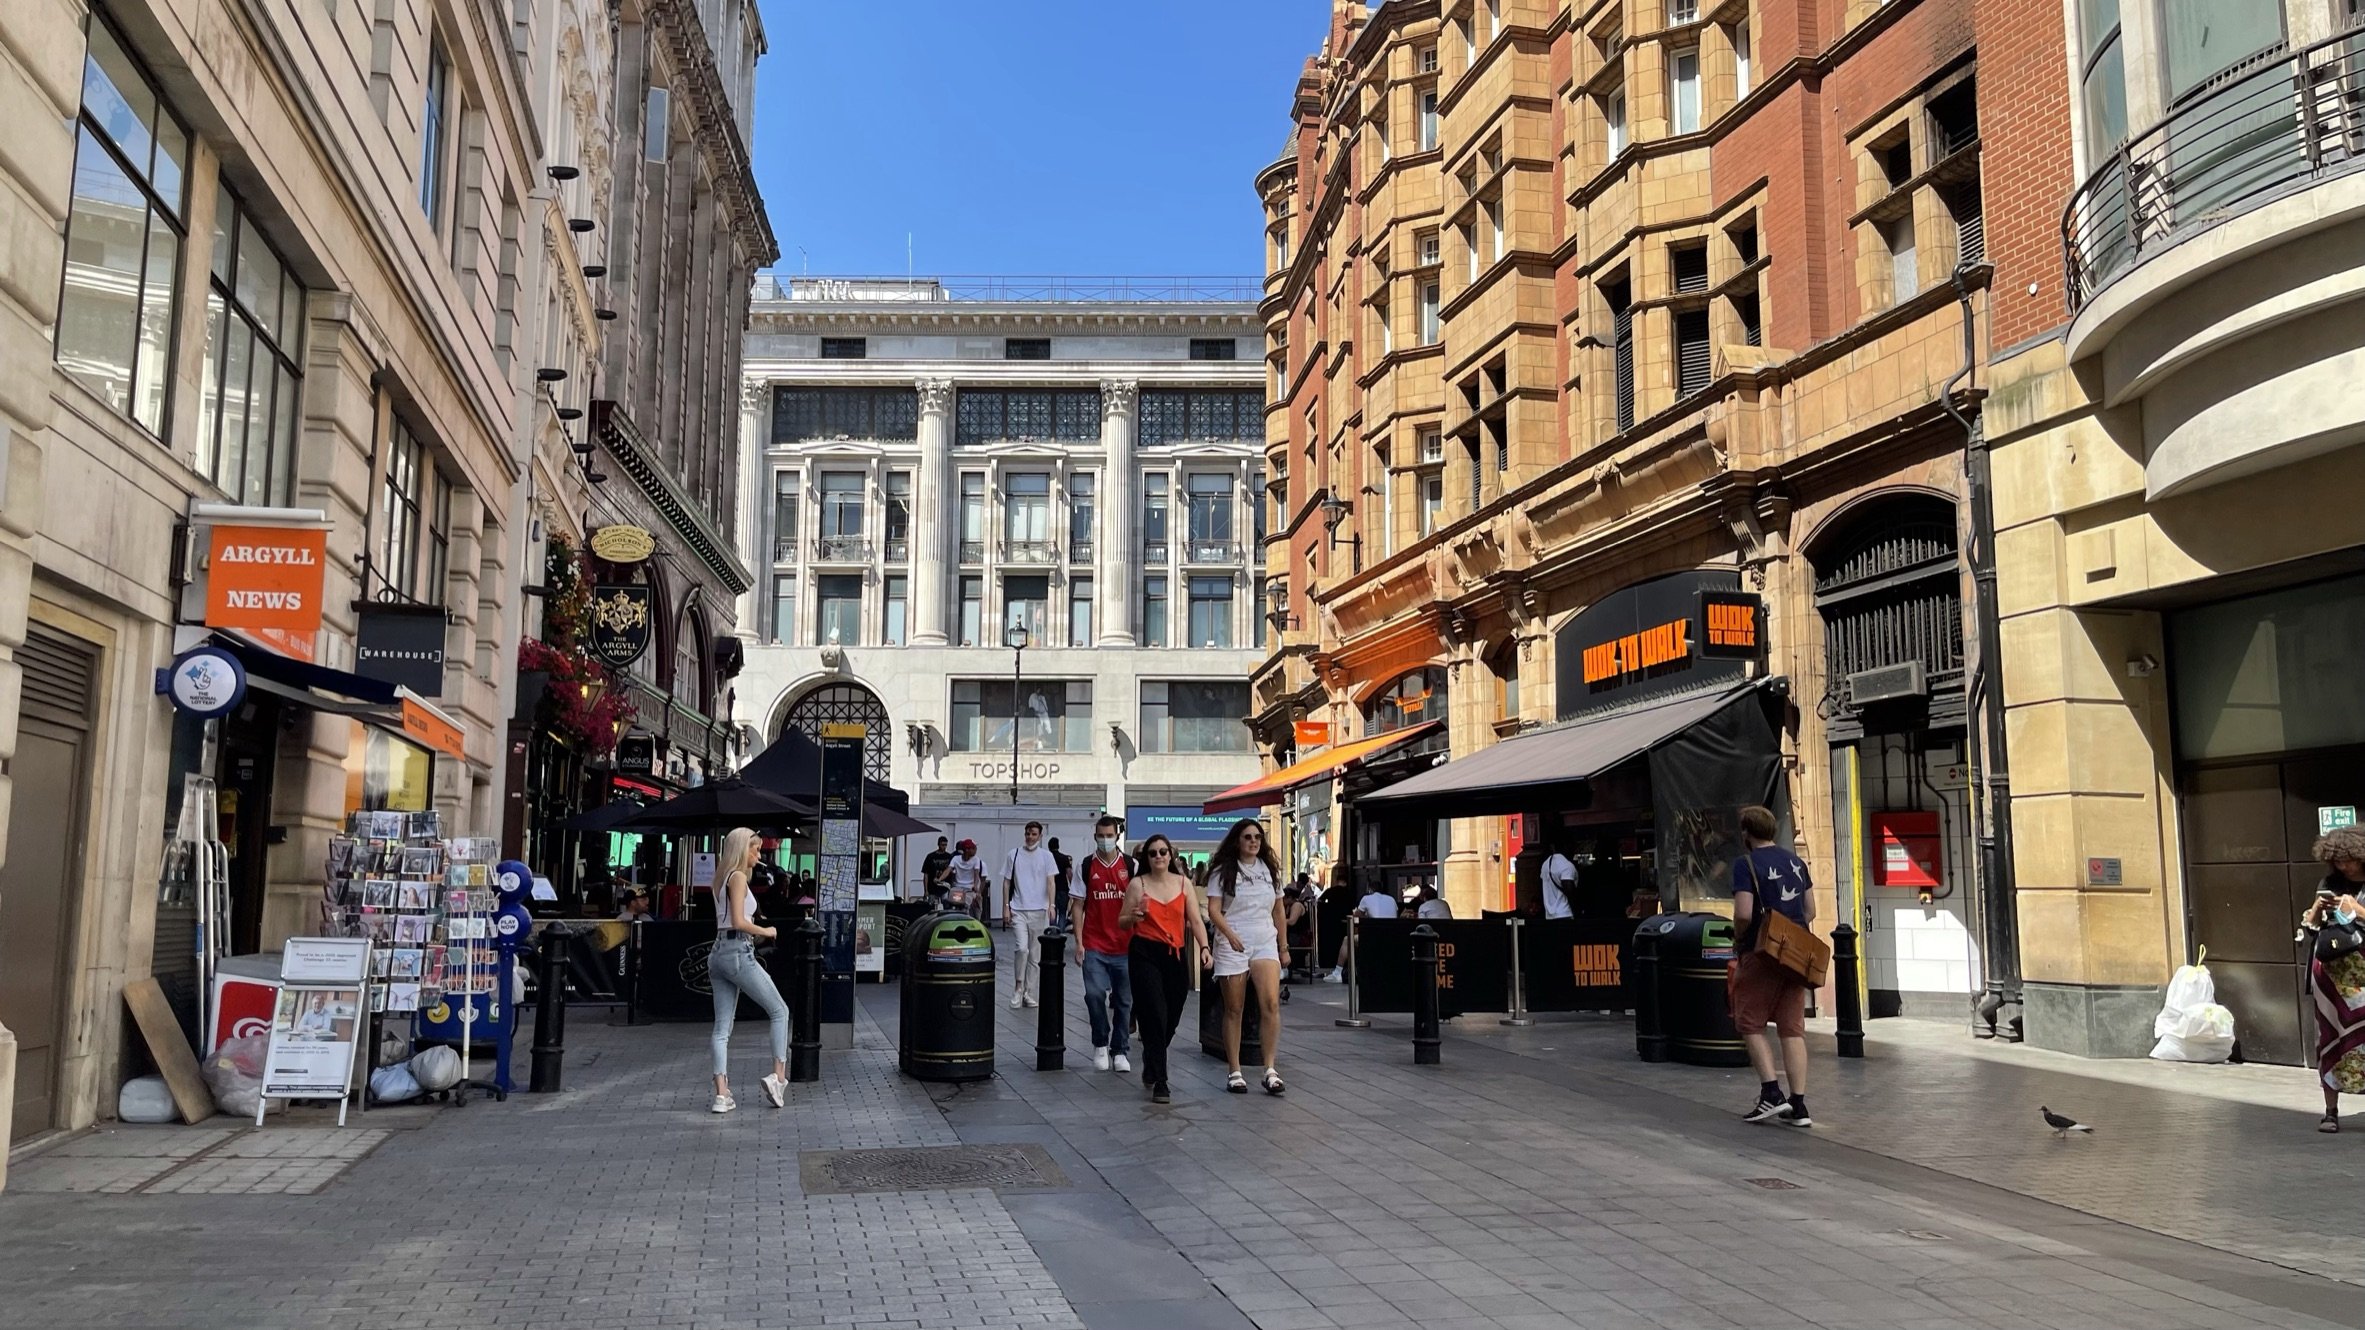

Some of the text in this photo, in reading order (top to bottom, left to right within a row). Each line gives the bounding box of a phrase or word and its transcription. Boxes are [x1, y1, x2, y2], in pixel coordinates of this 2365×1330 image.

[220, 546, 315, 565] ARGYLL
[226, 590, 301, 610] NEWS
[1708, 604, 1754, 631] WOK
[602, 642, 638, 650] ARGYLL
[1709, 631, 1755, 646] TO WALK
[607, 649, 633, 657] ARMS
[1583, 618, 1687, 684] WOK TO WALK
[622, 757, 649, 765] ANGUS
[969, 763, 1060, 779] TOPSHOP
[2334, 809, 2351, 817] Fire
[2334, 817, 2351, 825] exit
[1093, 890, 1126, 899] Emirat
[1105, 883, 1117, 891] Fly
[618, 945, 626, 976] GUINNESS
[1573, 945, 1620, 971] WOK
[1574, 971, 1621, 987] TO WALK
